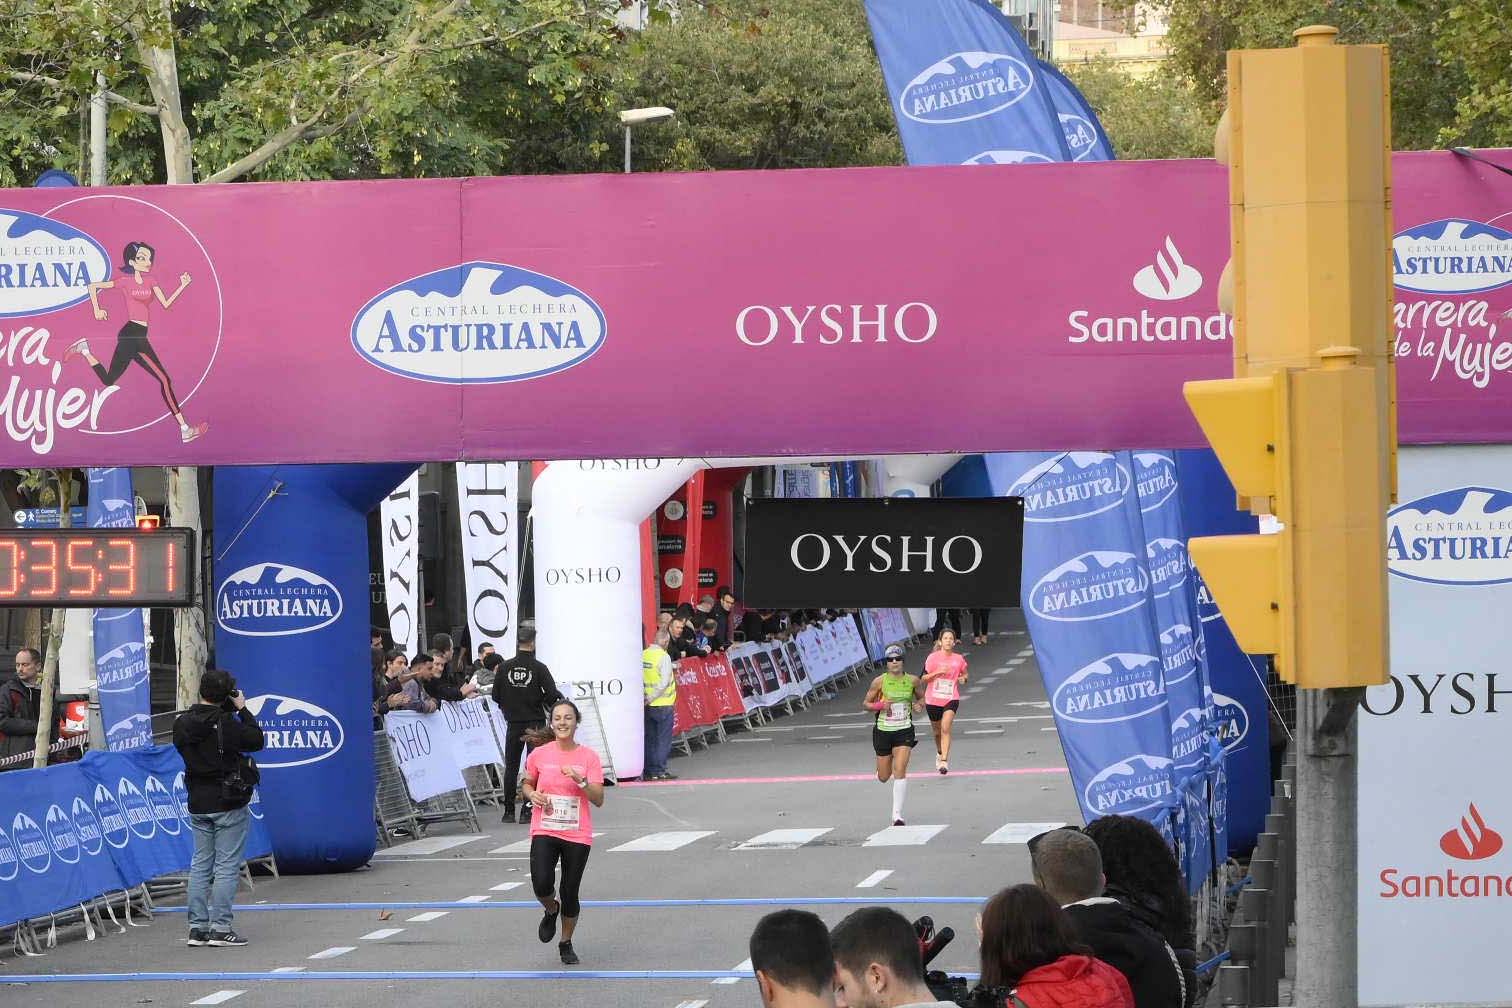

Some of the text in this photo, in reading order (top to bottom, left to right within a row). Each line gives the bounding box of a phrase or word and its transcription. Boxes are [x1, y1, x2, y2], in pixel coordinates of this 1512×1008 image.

[13, 244, 86, 256] LECHERA
[410, 302, 578, 318] CENTRAL LECHERA
[371, 309, 587, 353] ASTURIANA
[735, 302, 938, 347] OYSHO
[1417, 330, 1435, 357] la
[1414, 522, 1481, 532] CENTRAL
[790, 533, 983, 574] OYSHO
[545, 566, 622, 586] OYSHO
[233, 587, 329, 597] CENTRAL LECHERA
[221, 592, 334, 620] ASTURIANA
[513, 671, 527, 681] BP
[280, 719, 330, 728] LECHERA
